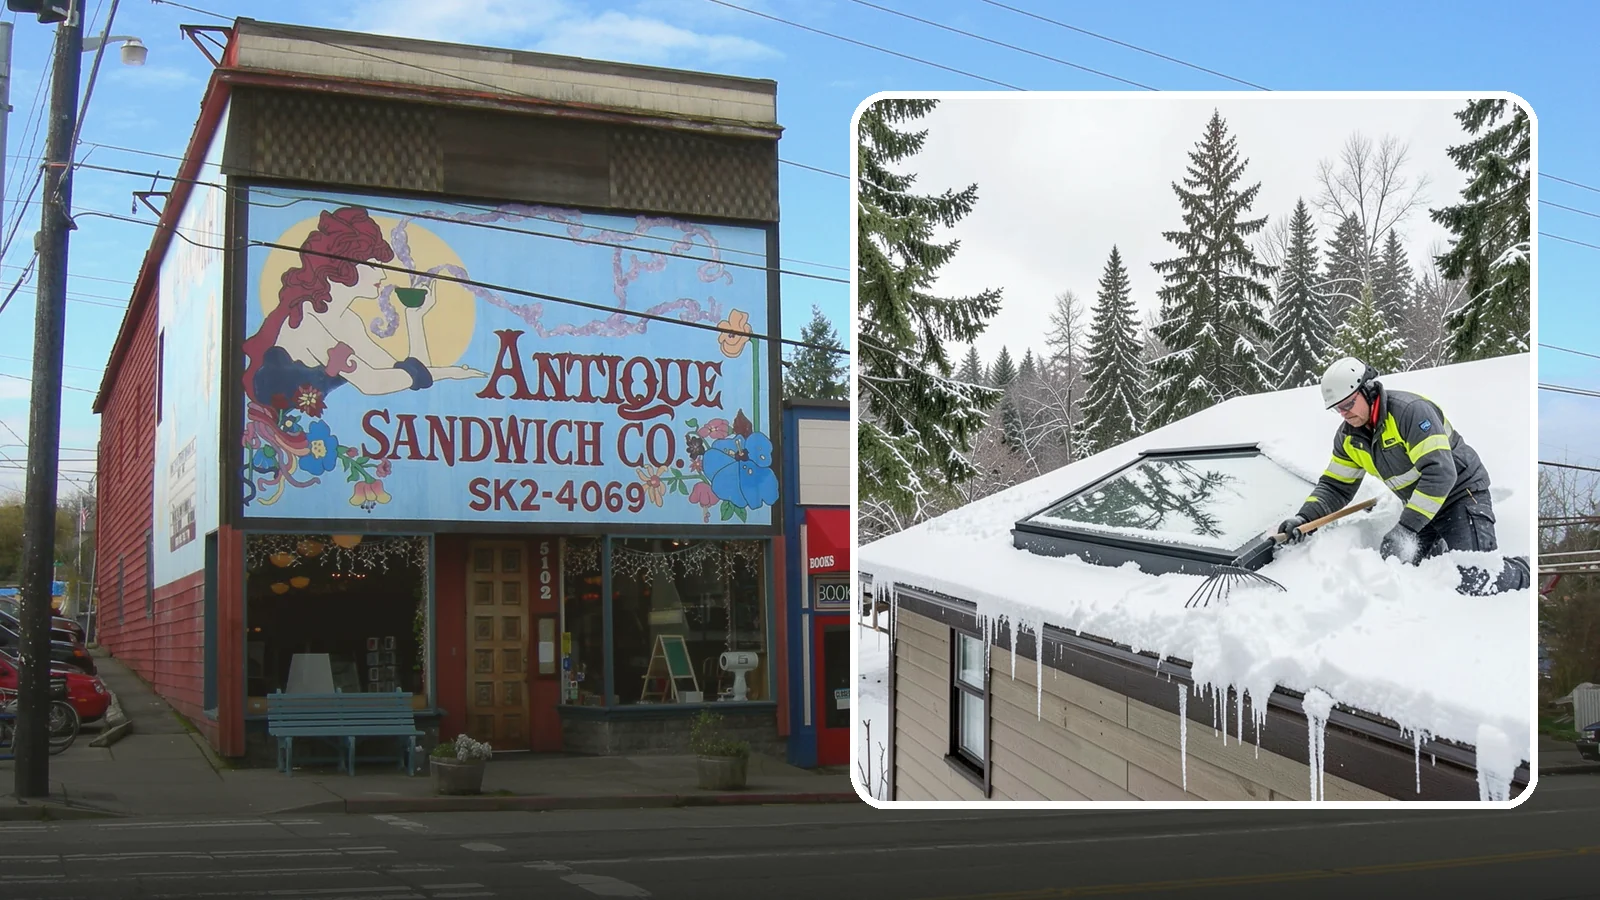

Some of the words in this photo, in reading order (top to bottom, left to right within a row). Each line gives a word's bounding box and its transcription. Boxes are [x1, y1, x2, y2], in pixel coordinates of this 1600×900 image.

[476, 328, 724, 421] ANTIQUE
[361, 408, 604, 467] SANDWICH
[617, 422, 685, 468] CO.
[468, 477, 646, 513] SK2-4069
[539, 541, 552, 600] 5102
[809, 555, 835, 569] BOOKS
